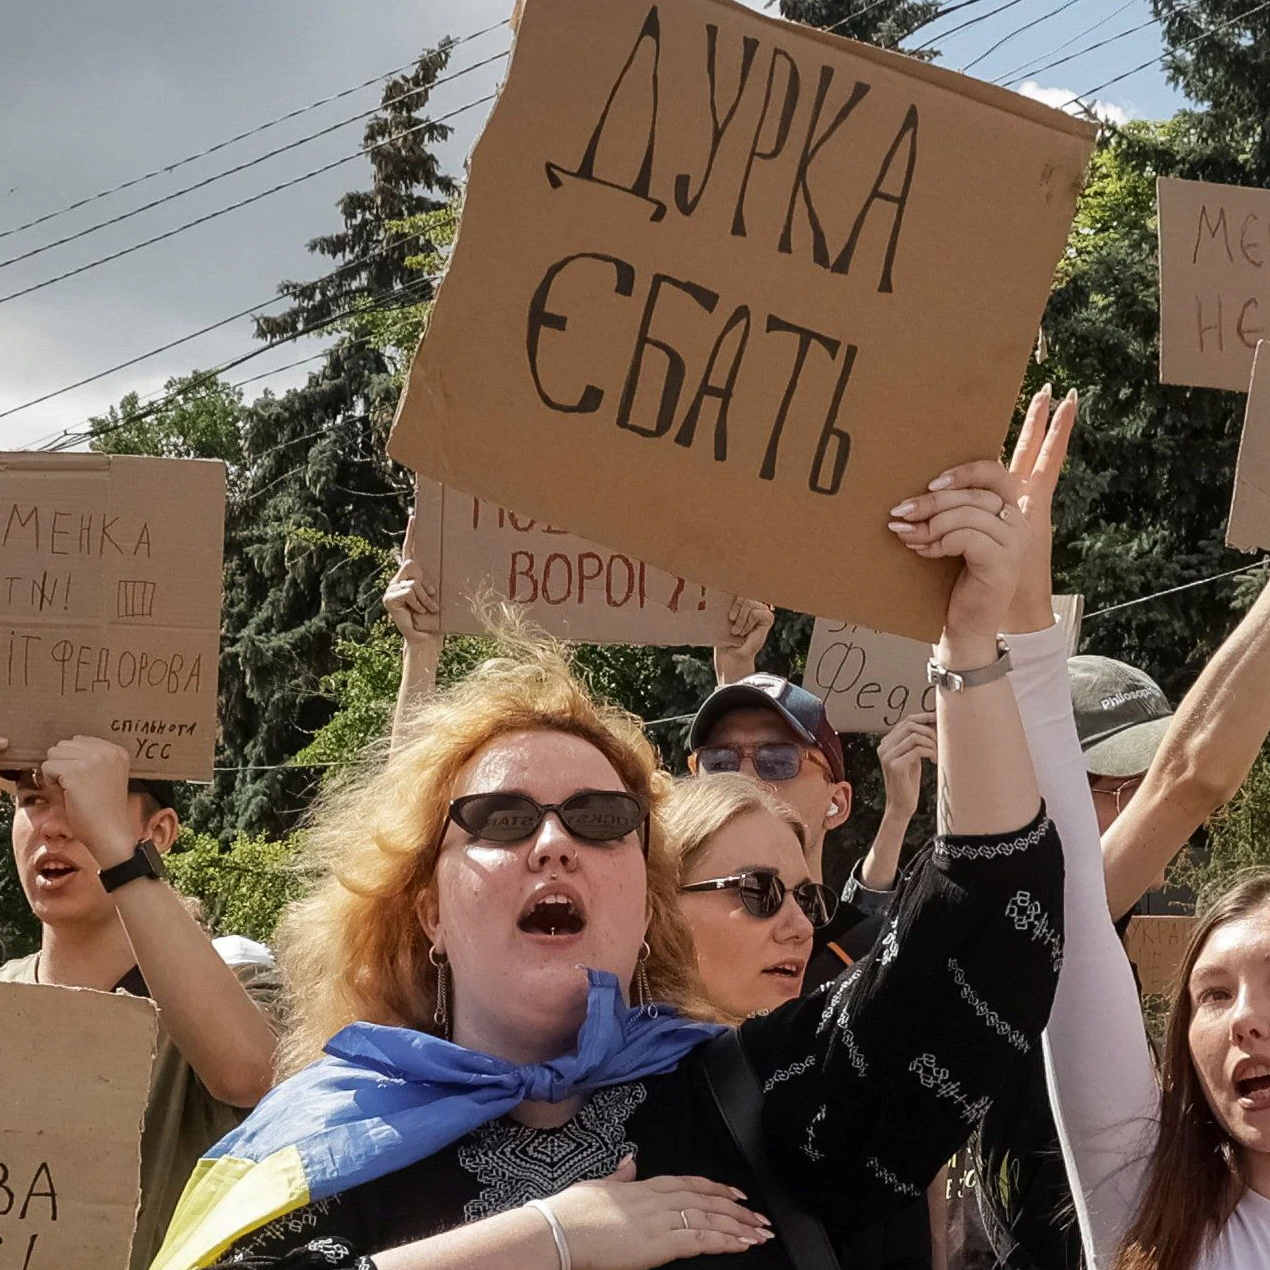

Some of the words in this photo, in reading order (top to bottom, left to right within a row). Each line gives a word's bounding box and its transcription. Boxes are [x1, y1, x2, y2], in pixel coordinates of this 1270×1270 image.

[545, 5, 919, 294] ДУРКА
[526, 252, 859, 496] ЄБАТЬ
[50, 638, 203, 696] ФЕДОРОВА
